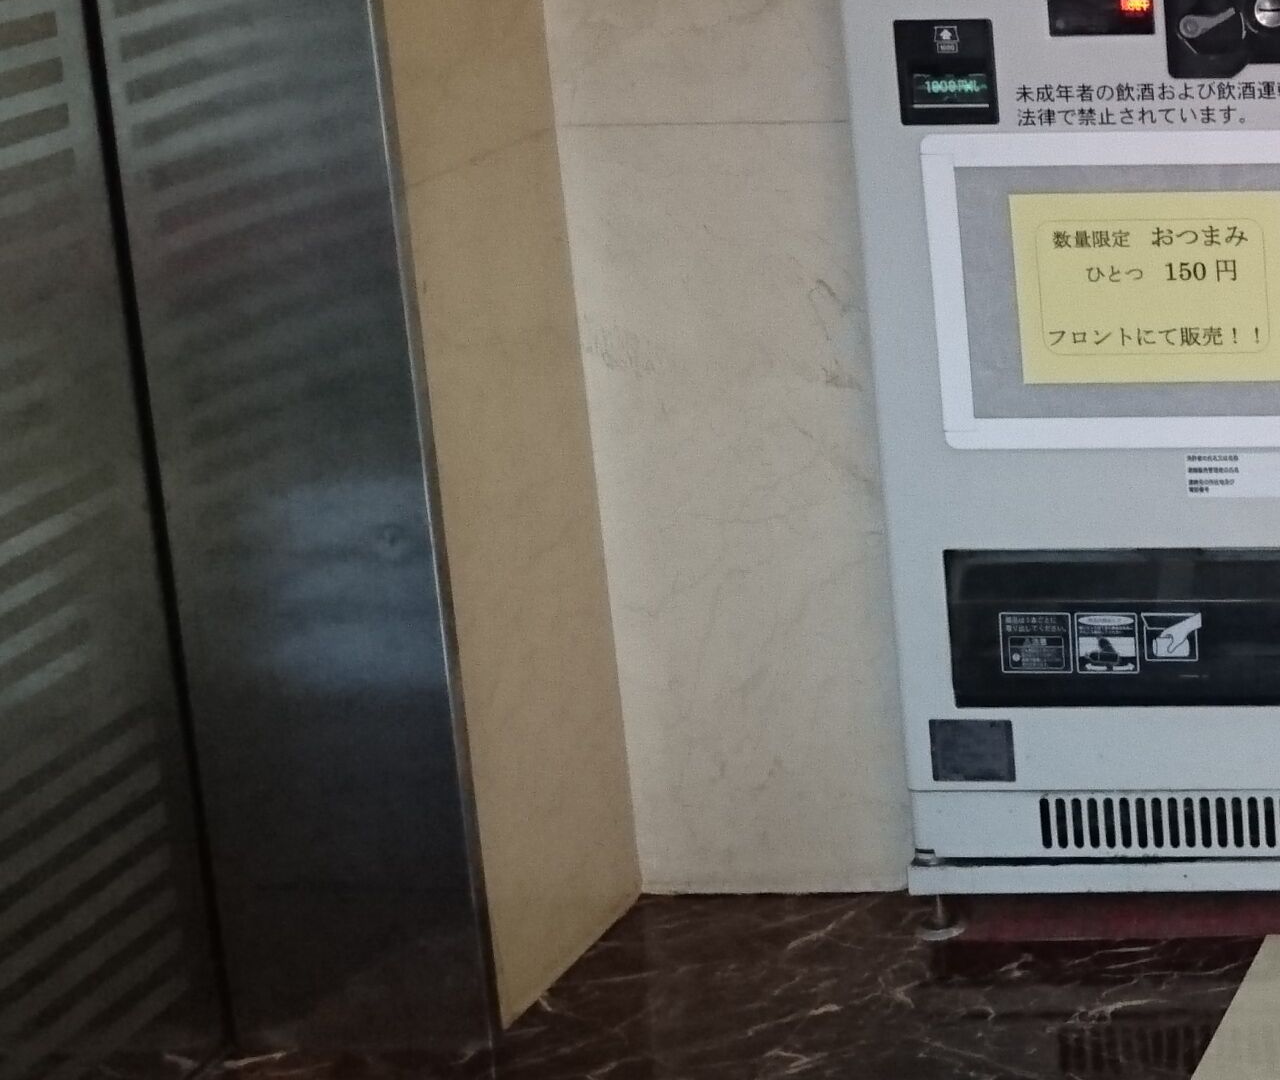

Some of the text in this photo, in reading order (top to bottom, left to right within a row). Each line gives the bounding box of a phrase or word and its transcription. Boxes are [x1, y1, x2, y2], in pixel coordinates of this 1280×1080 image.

[1017, 107, 1248, 127] 法律で禁止されています。
[1052, 225, 1249, 249] 数量限定 おつまみ
[1086, 265, 1144, 282] ひとつ
